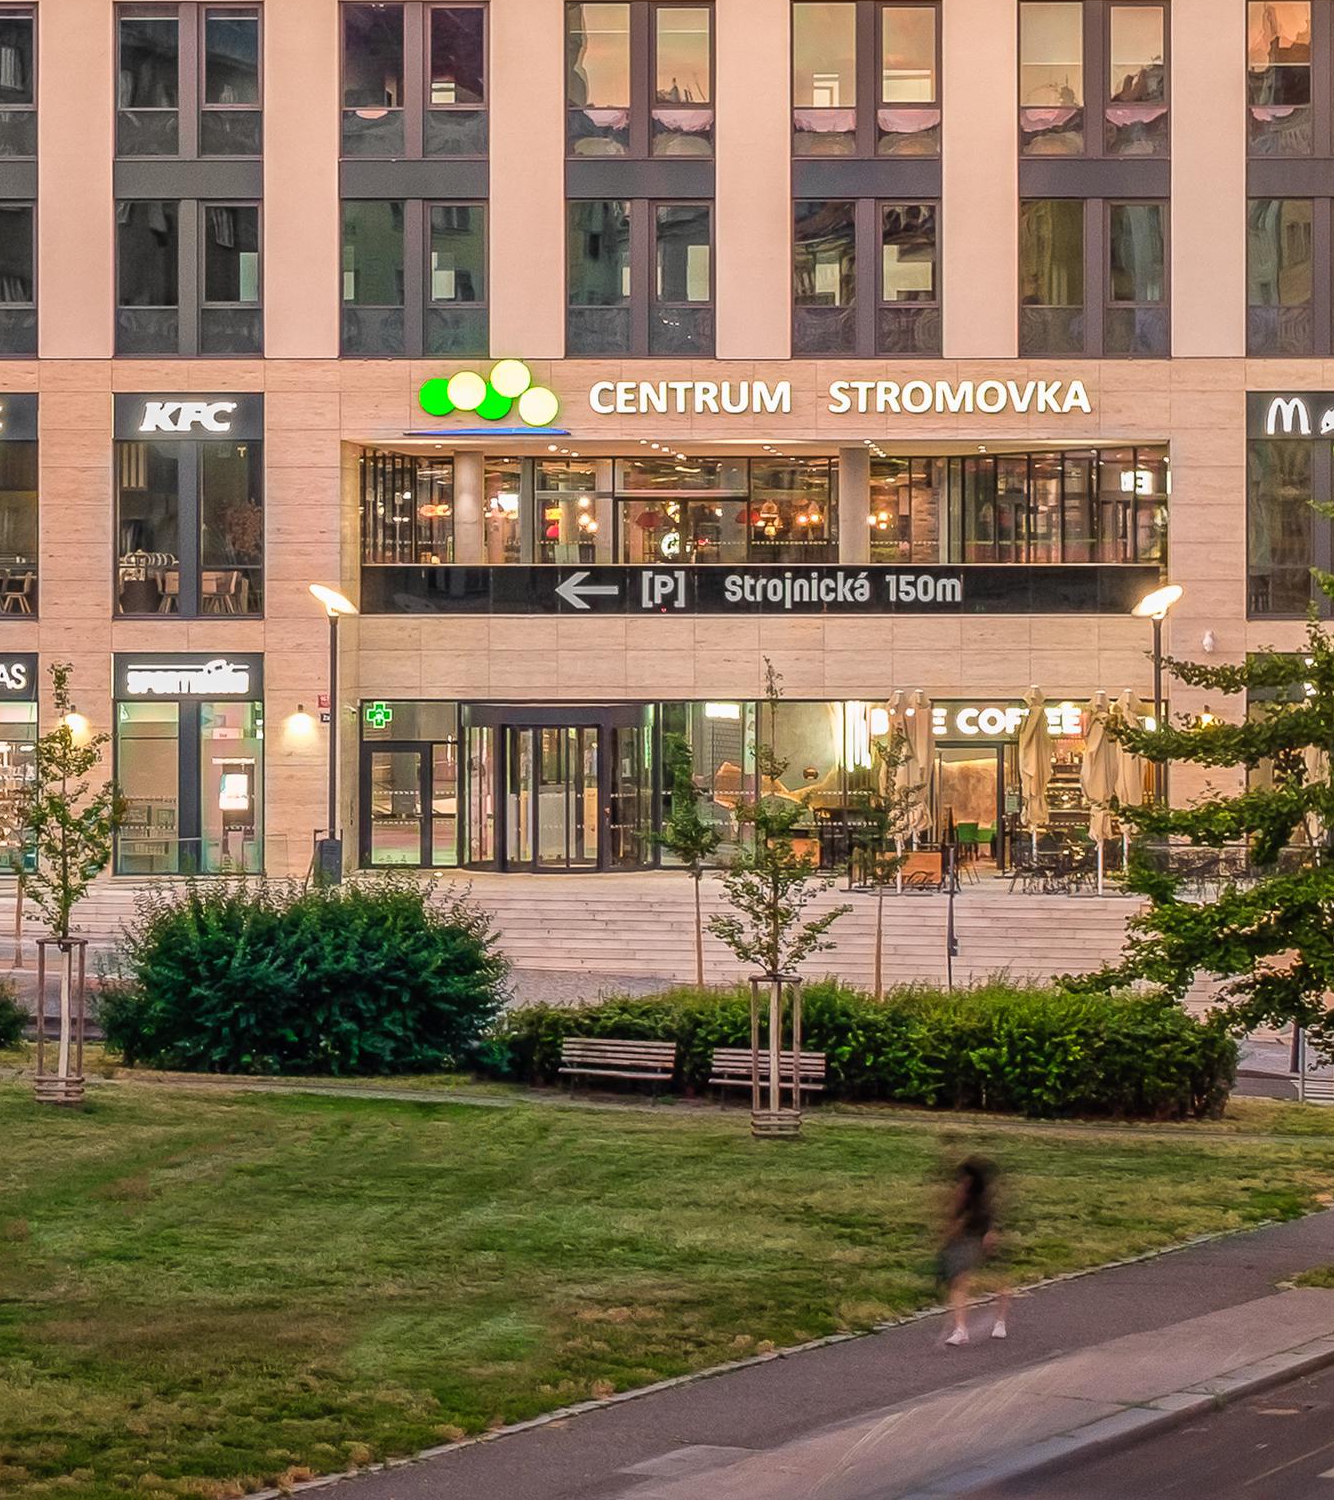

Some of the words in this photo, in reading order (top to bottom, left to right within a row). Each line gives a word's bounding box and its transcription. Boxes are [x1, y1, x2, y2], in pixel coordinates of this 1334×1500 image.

[588, 380, 791, 414] CENTRUM
[828, 380, 1092, 414] STROMOVKA
[138, 401, 237, 432] KFC
[724, 571, 870, 609] Strojnická
[885, 574, 962, 603] 150m
[956, 707, 1082, 735] COFEE
